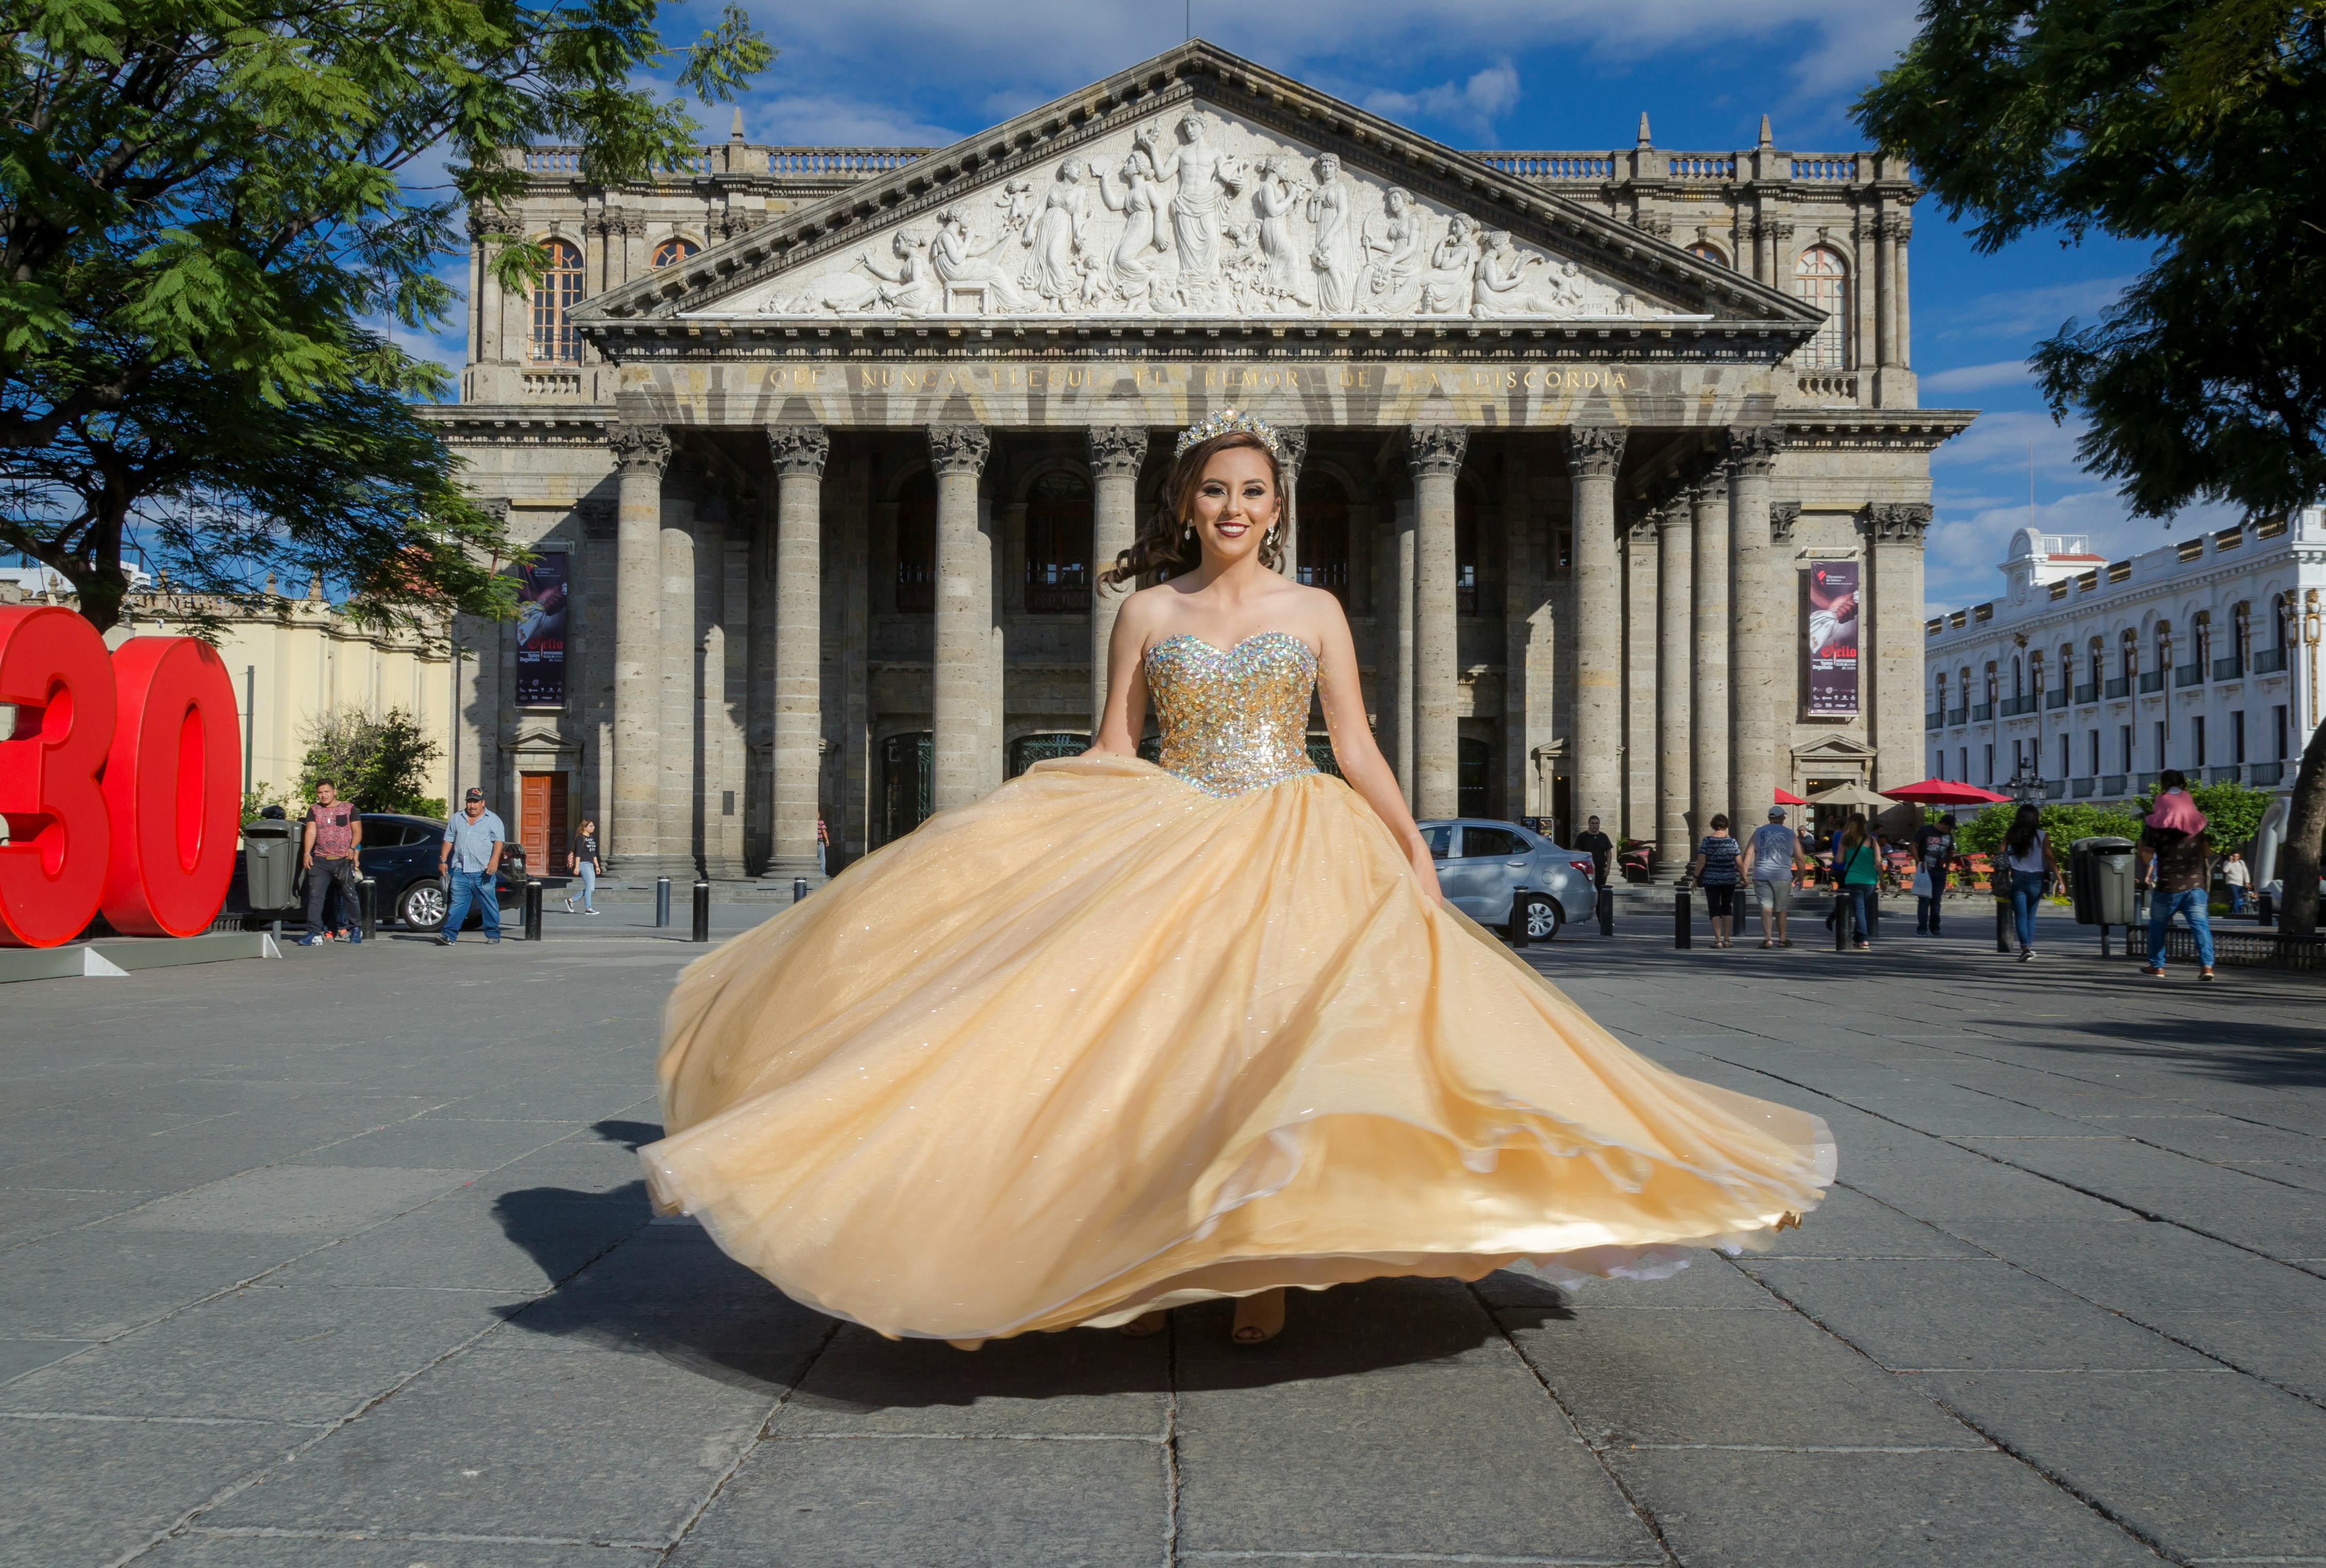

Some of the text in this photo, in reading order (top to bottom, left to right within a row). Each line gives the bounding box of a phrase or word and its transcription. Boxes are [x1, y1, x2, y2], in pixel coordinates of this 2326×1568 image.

[770, 369, 1627, 389] QUE NUNCA LLEGUE EL RUMOR DE LA DISCORDIA
[0, 605, 242, 948] 30
